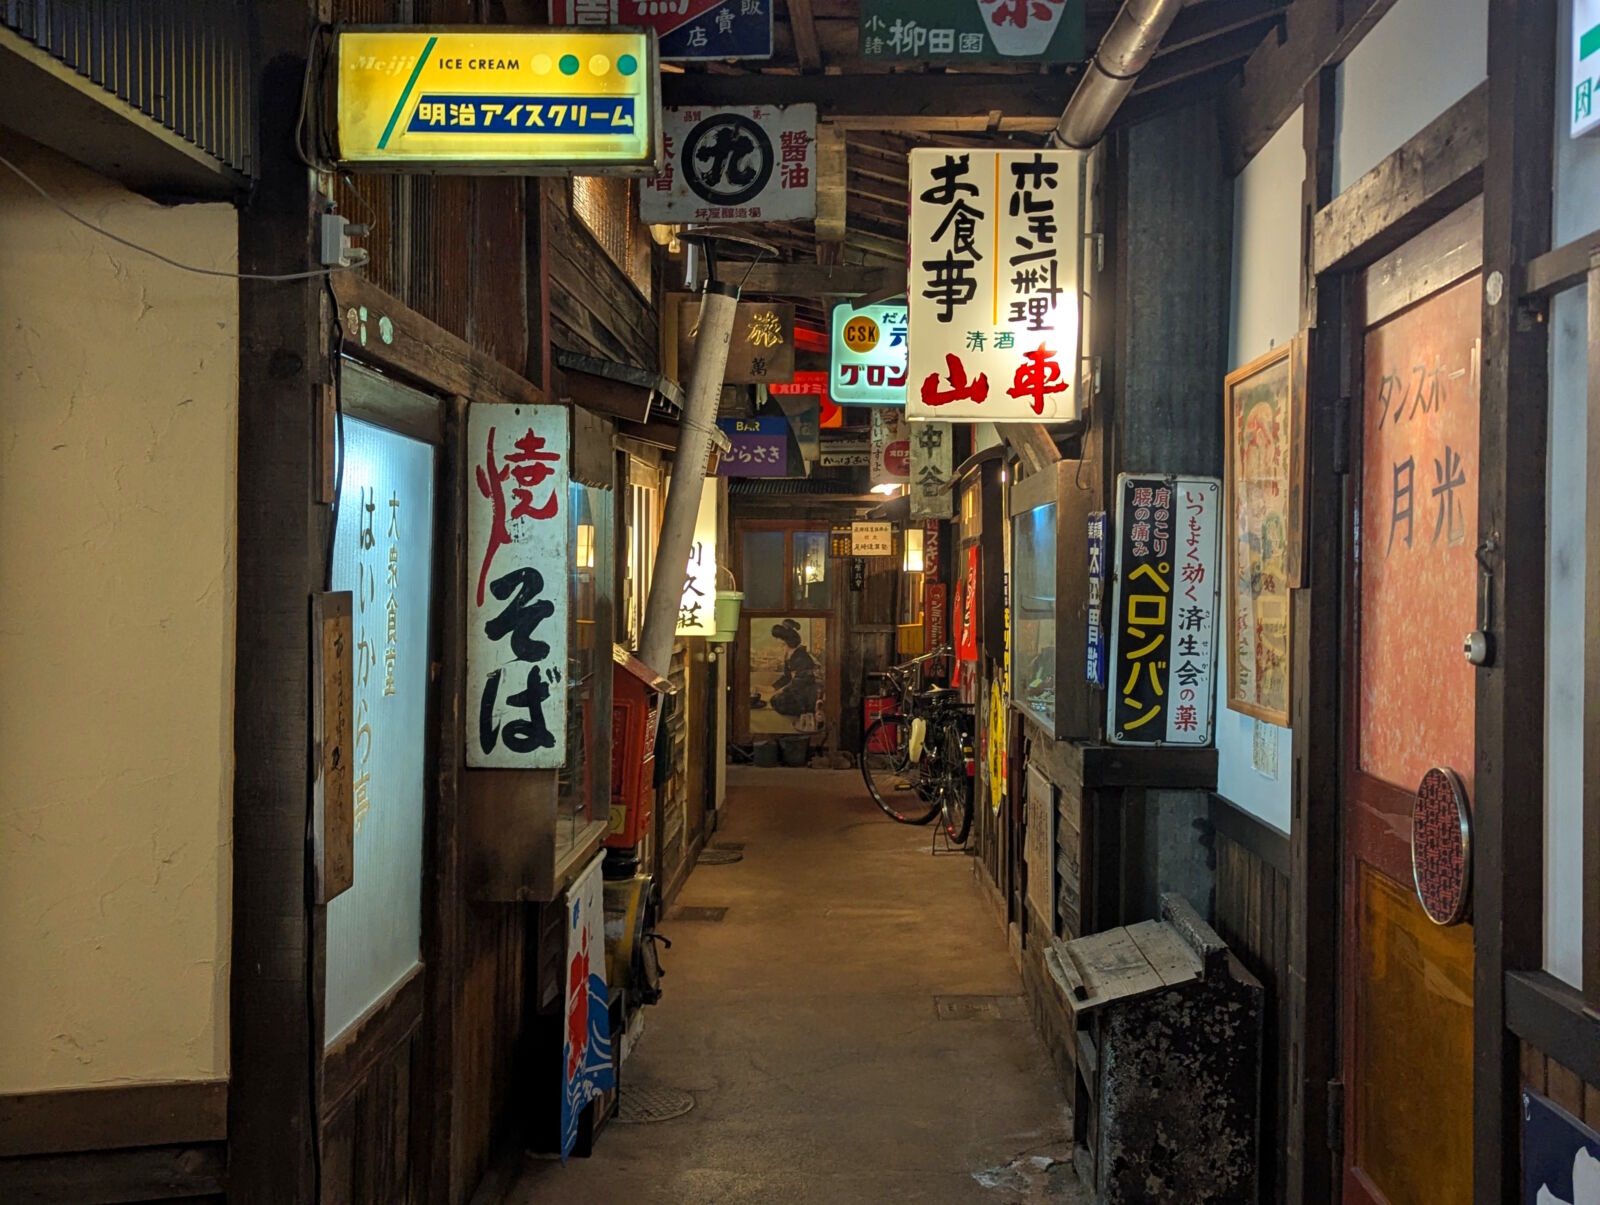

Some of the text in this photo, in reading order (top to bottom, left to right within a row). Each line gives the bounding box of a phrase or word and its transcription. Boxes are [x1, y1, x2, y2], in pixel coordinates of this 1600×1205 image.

[350, 55, 416, 77] Meiji
[439, 60, 520, 70] ICE CREAM
[418, 103, 635, 128] 明治アイスクリーム
[920, 153, 984, 323] お食事
[1009, 153, 1063, 331] ホルモン料理
[847, 326, 876, 342] CSK
[966, 330, 1015, 352] 清酒
[721, 445, 779, 463] むらさき
[736, 421, 760, 431] BAR
[914, 424, 945, 497] 中谷
[1131, 487, 1152, 557] 腰の痛み
[1151, 488, 1170, 557] 肩のこり
[1385, 445, 1467, 559] 月光
[476, 427, 562, 754] 焼そば
[1122, 562, 1170, 731] ペロンバン
